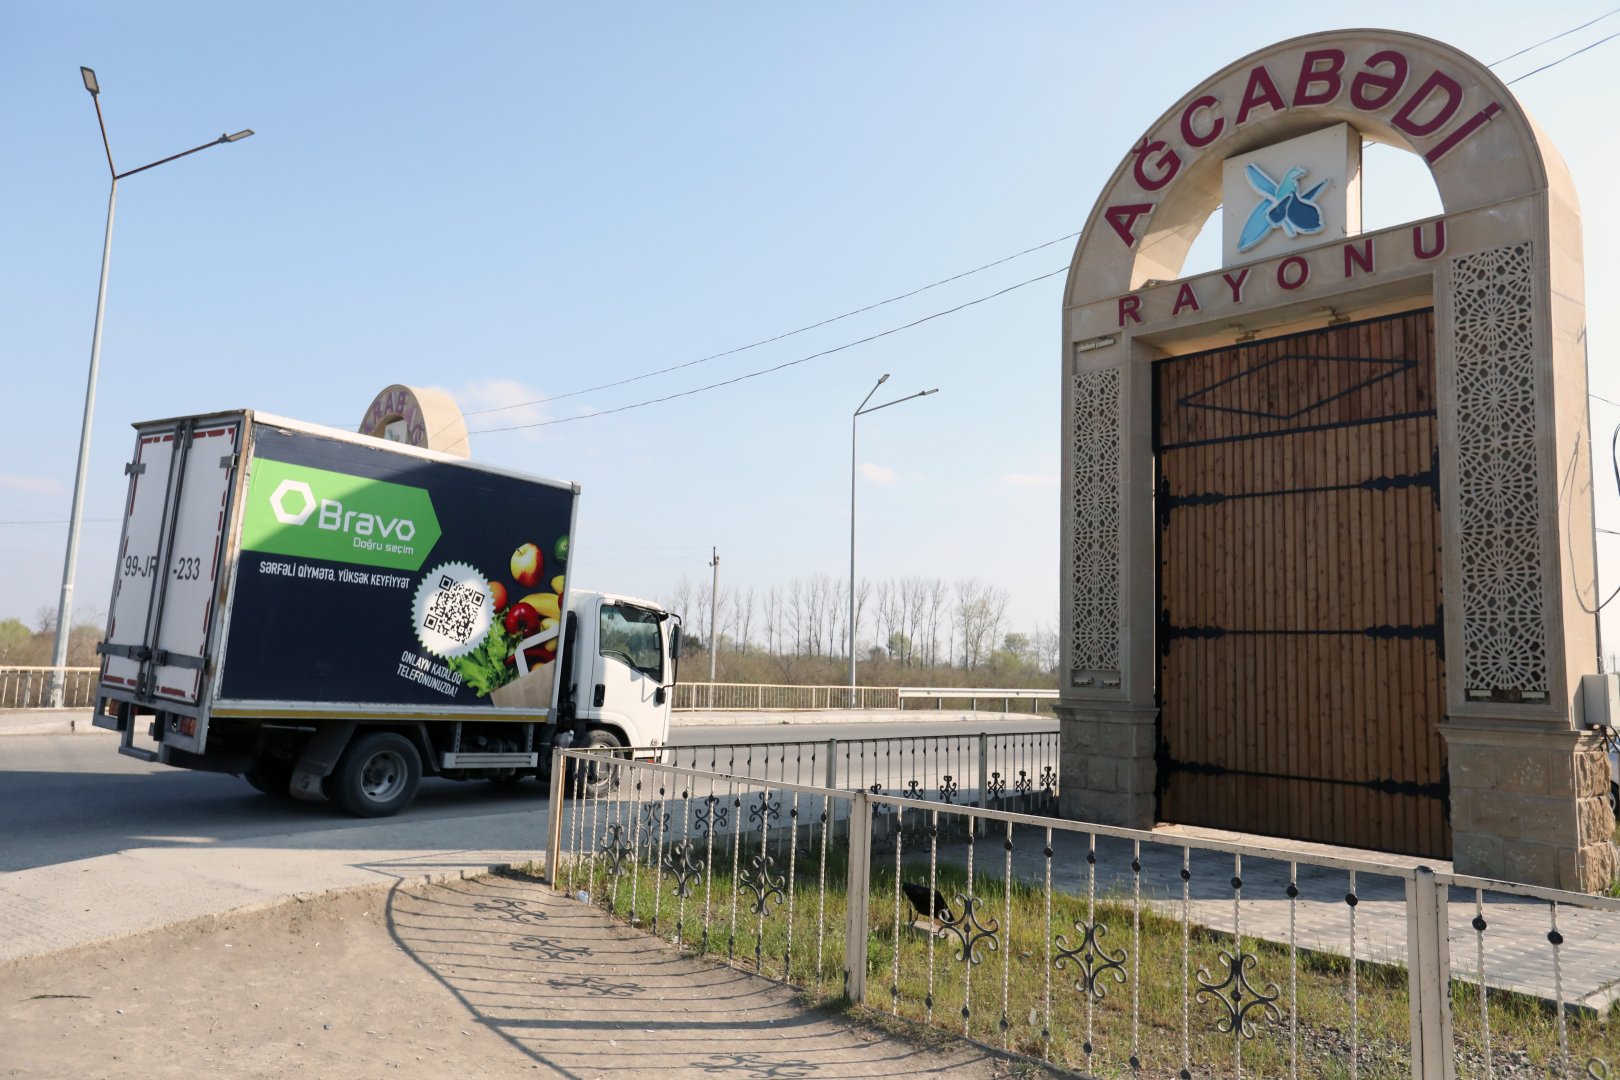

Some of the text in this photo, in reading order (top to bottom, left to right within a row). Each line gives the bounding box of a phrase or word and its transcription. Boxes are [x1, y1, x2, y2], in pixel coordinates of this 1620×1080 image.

[1105, 48, 1503, 247] AĞCABƏDİ
[1118, 219, 1448, 327] RAYONU
[318, 498, 416, 542] Bravo
[353, 537, 383, 551] Doğru
[338, 569, 369, 585] YÜKSƏK
[397, 663, 459, 697] TELEFONUNUZDA!
[401, 650, 463, 685] ONLAYN KATALOQ
